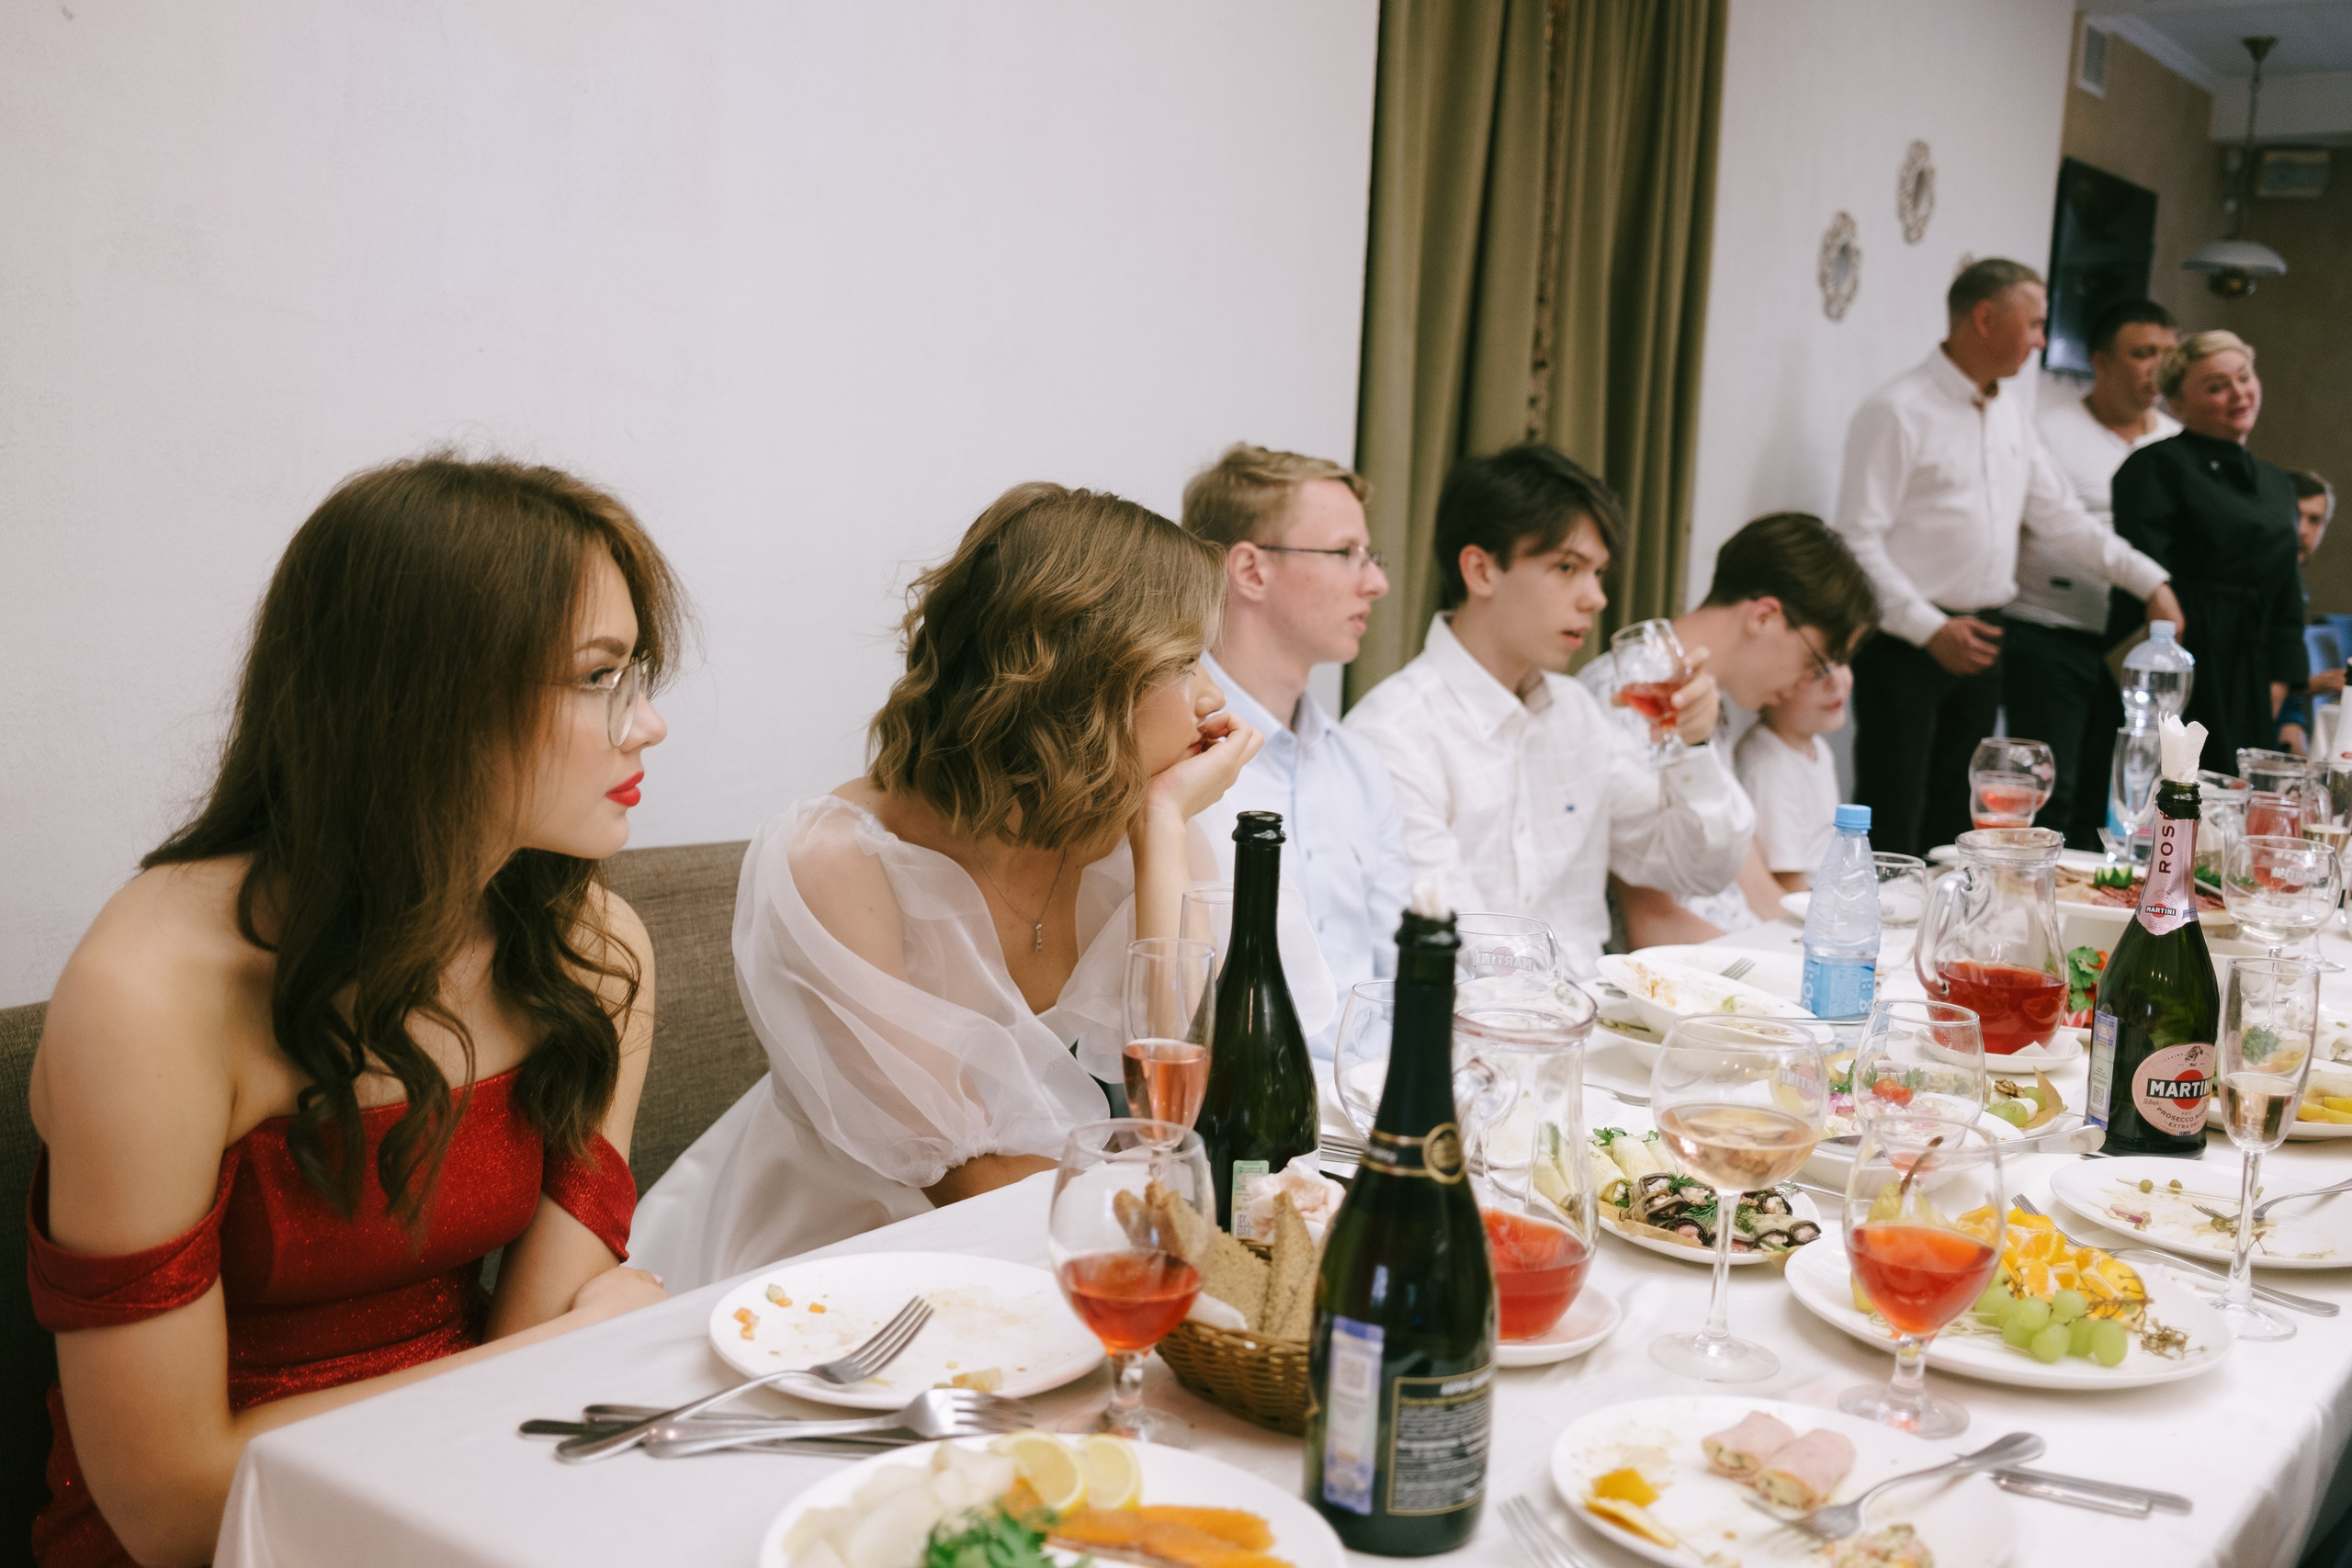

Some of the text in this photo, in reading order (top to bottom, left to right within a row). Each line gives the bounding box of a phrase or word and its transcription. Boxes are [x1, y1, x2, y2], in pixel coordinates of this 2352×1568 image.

[2145, 906, 2176, 916] MARTINI
[2149, 1077, 2211, 1098] MARTIN
[2156, 1106, 2194, 1122] PROSECCO
